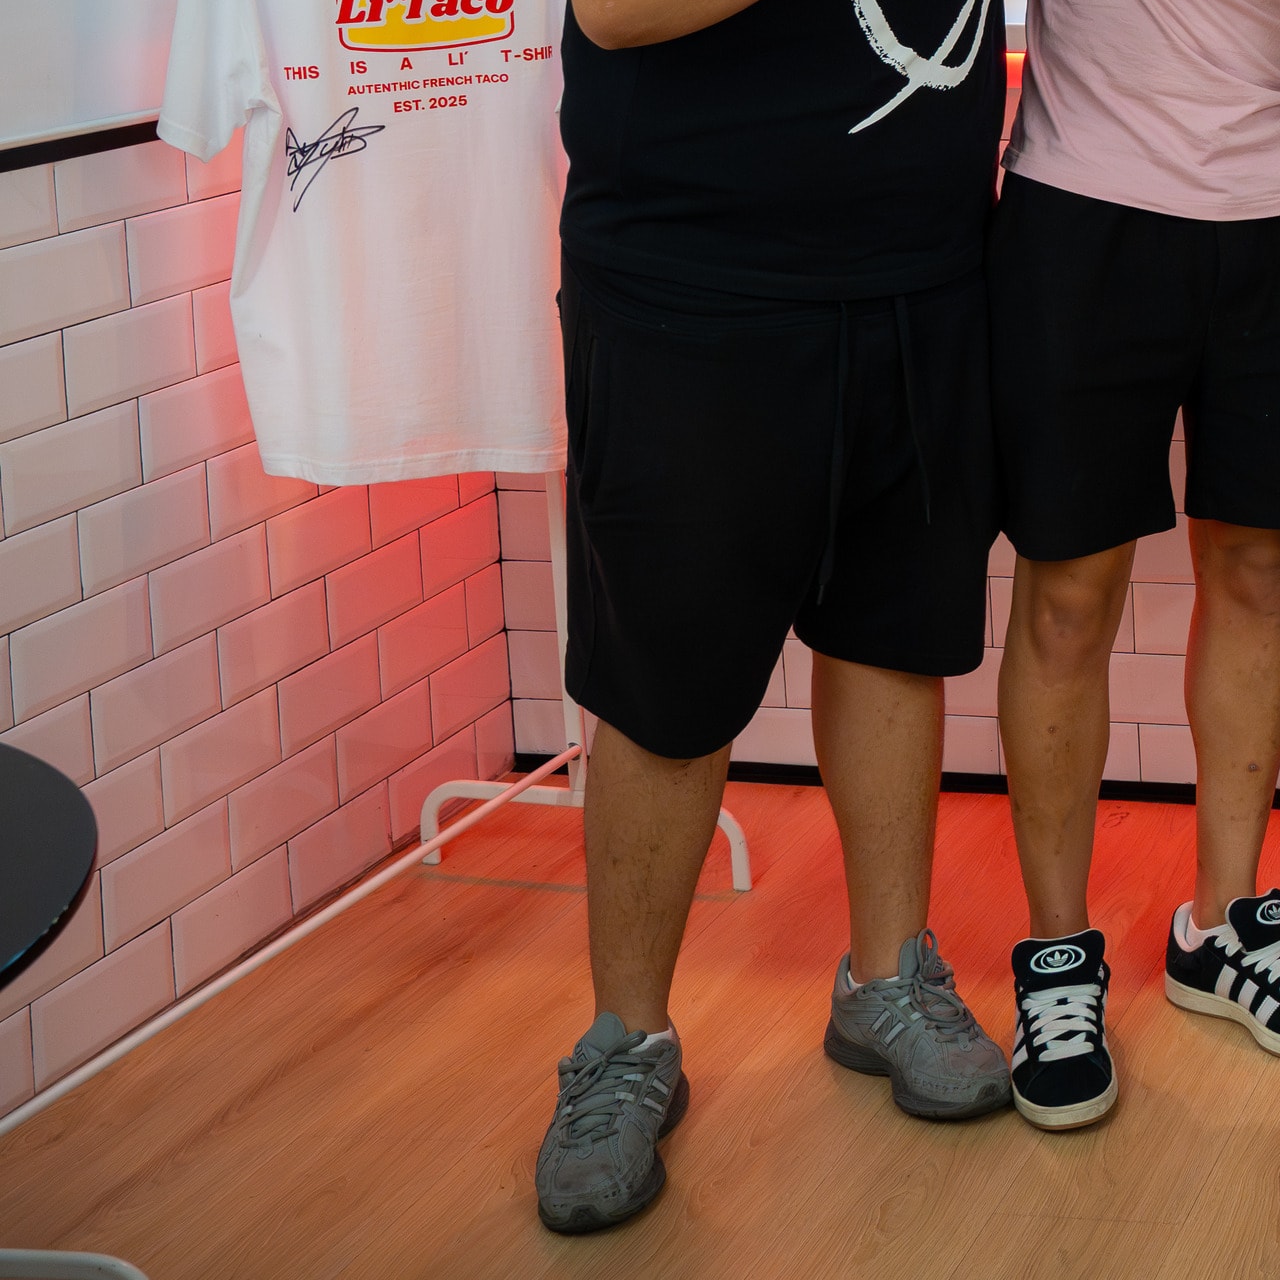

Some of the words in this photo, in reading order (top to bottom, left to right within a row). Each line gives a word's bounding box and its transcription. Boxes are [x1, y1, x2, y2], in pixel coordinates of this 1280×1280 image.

[284, 66, 320, 81] THIS
[350, 61, 367, 75] IS
[400, 57, 413, 71] A
[500, 45, 553, 63] T-SHIR
[347, 79, 420, 96] AUTENTHIC
[423, 76, 472, 90] FRENCH
[476, 73, 509, 85] TACO
[394, 100, 425, 113] EST.
[429, 94, 468, 110] 2025
